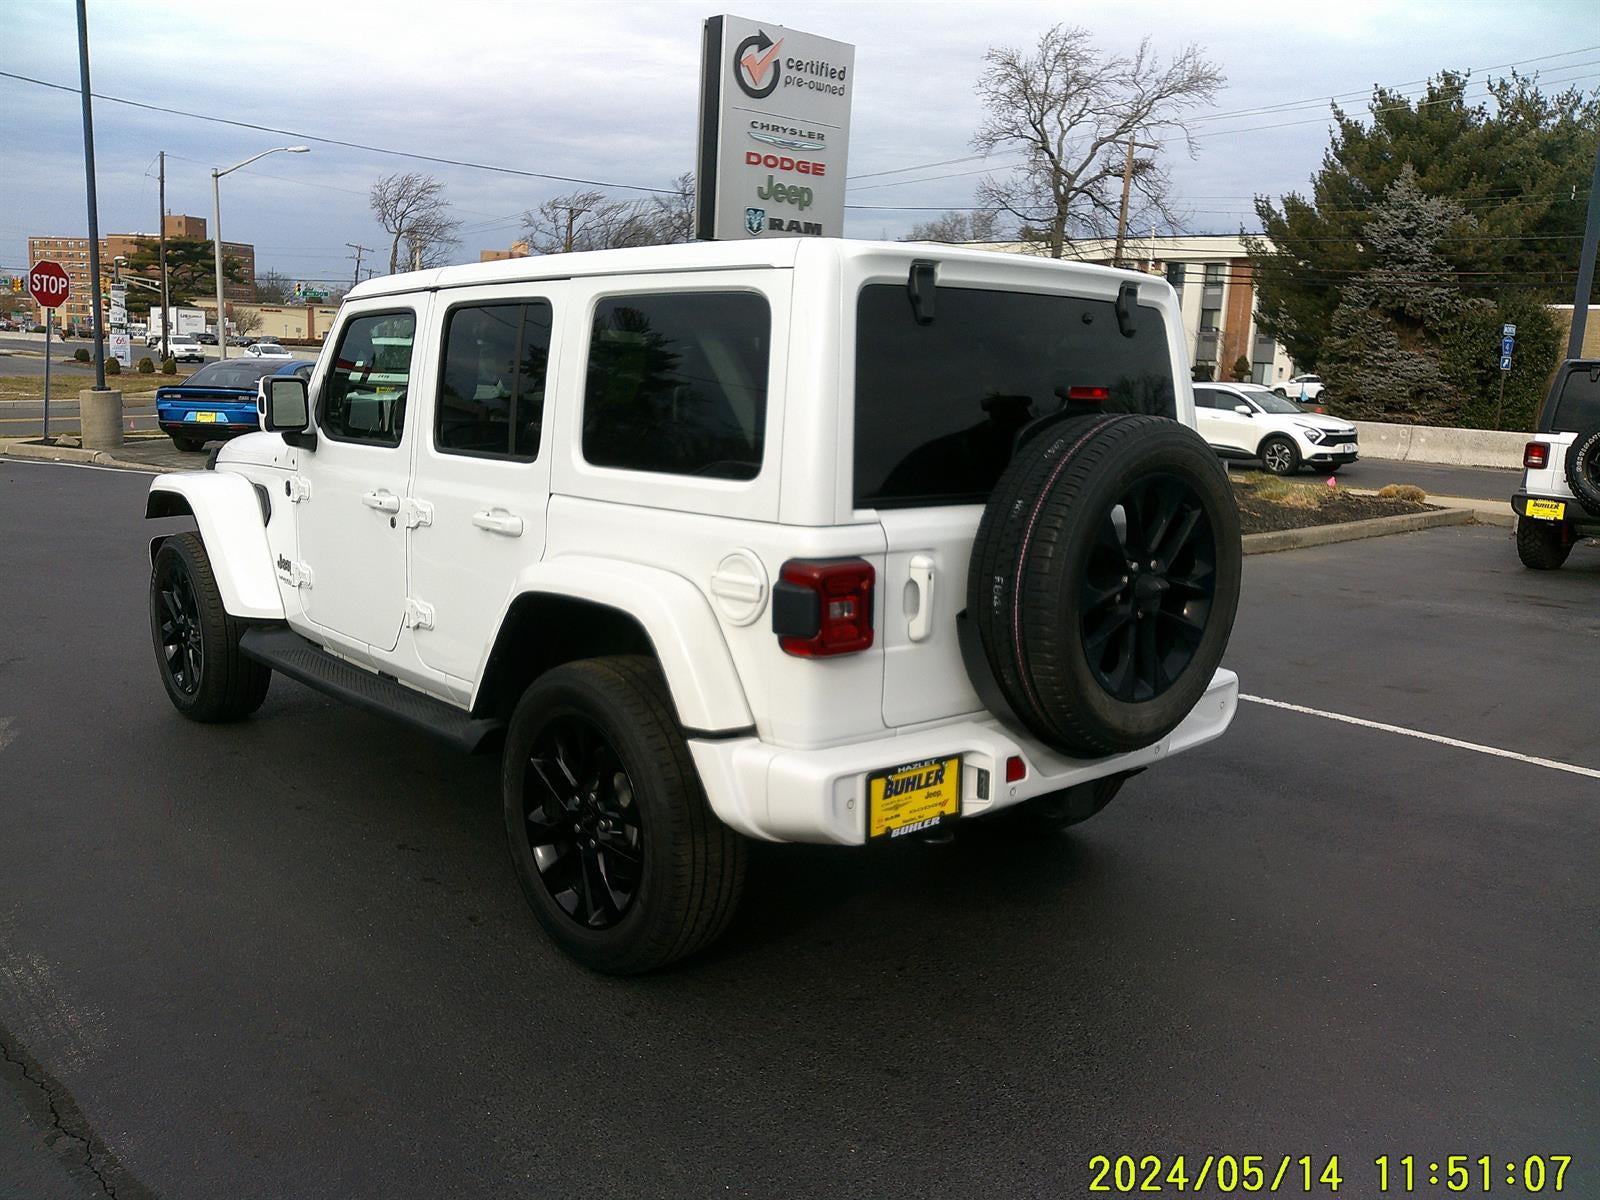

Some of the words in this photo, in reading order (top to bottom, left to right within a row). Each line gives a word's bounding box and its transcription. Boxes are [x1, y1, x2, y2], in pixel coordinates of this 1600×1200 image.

[786, 57, 846, 81] certified
[784, 74, 846, 96] pre-owned
[750, 120, 825, 141] CHRYSLER
[745, 151, 825, 176] DODGE
[757, 174, 813, 210] Jeep
[768, 217, 822, 236] RAM
[32, 274, 67, 294] STOP
[897, 759, 937, 774] HAZLET
[882, 768, 945, 800] BUHLER
[924, 789, 942, 800] Jeep
[891, 816, 941, 838] BUHLER
